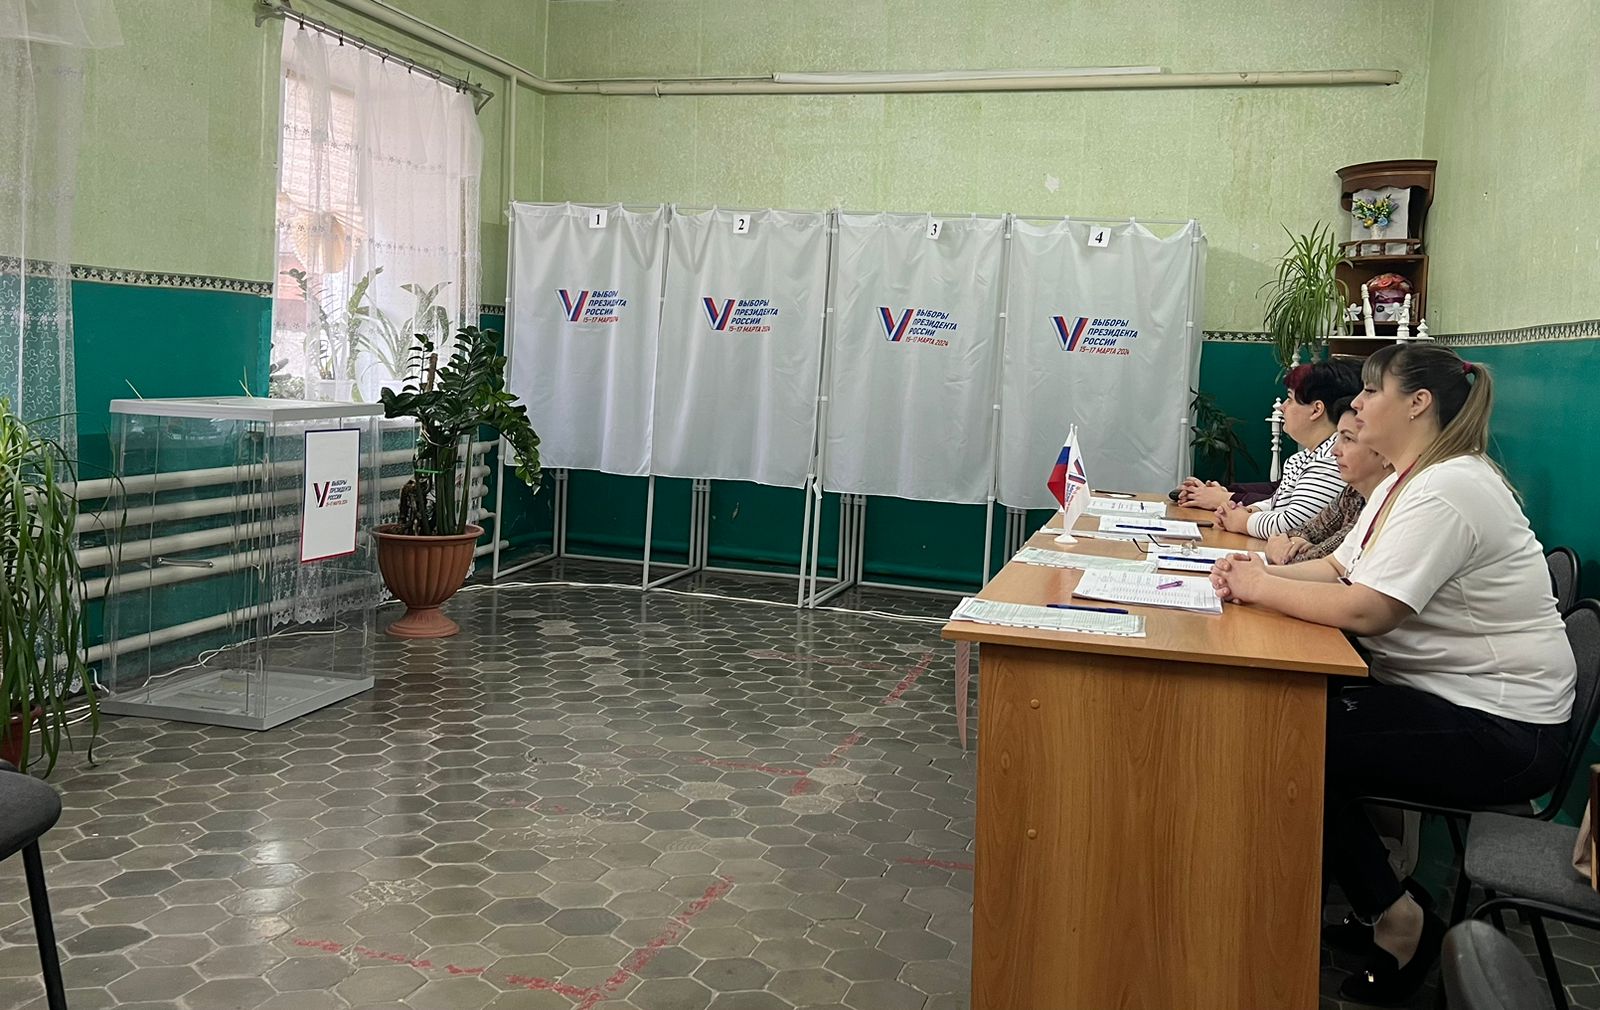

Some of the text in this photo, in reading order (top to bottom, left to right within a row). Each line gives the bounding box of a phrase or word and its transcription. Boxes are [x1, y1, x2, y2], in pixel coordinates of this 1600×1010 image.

[596, 214, 600, 225] 1
[738, 219, 745, 230] 2
[931, 223, 937, 236] 3
[1095, 231, 1104, 243] 4
[738, 299, 770, 307] ВЫБОРЫ
[734, 308, 778, 317] ПРЕЗИДЕНТА
[916, 308, 950, 320] ВЫБОРЫ
[731, 317, 761, 325] РОССИИ
[912, 318, 958, 331] ПРЕЗИДЕНТА
[1092, 318, 1129, 328] ВЫБОРЫ
[908, 327, 936, 337] РОССИИ
[1087, 327, 1138, 338] ПРЕЗИДЕНТА
[1082, 337, 1117, 346] РОССИИ
[1095, 347, 1116, 355] МАРТА
